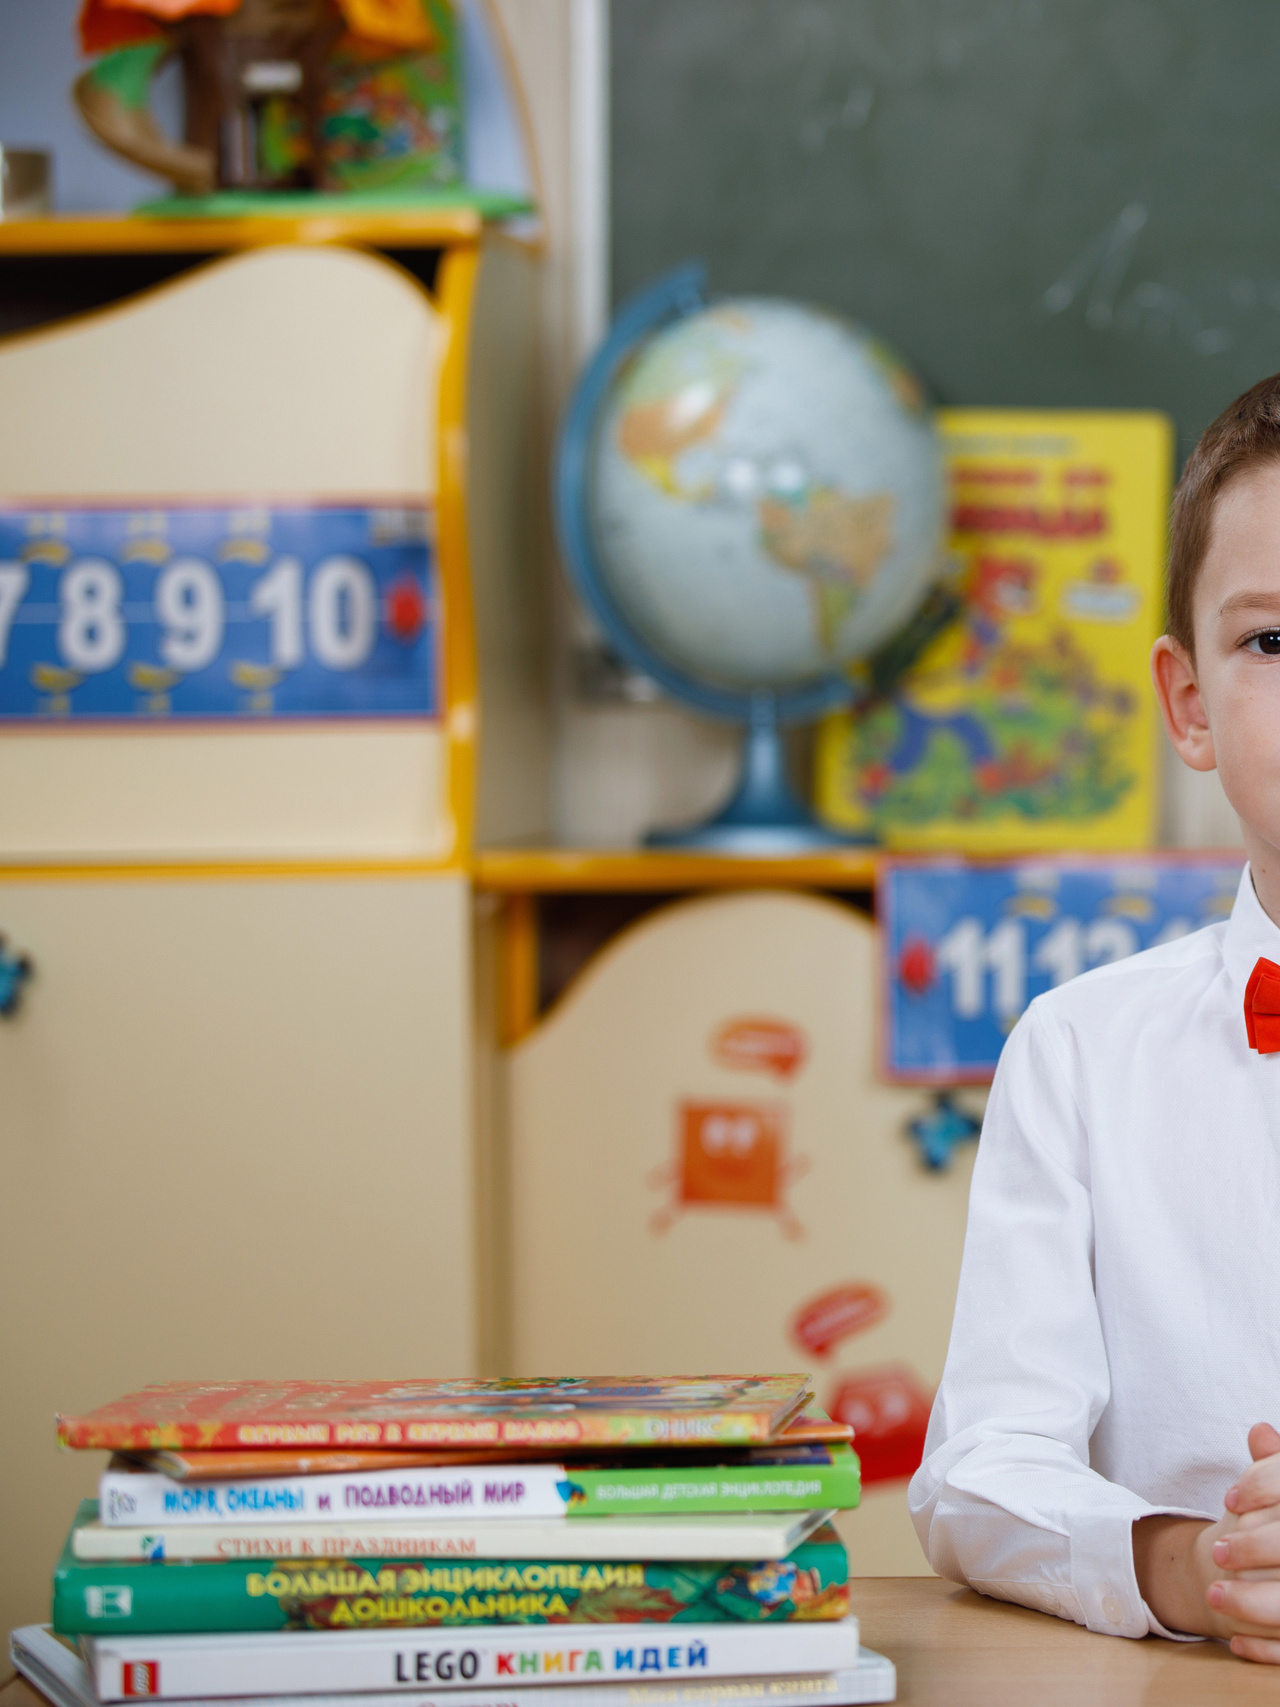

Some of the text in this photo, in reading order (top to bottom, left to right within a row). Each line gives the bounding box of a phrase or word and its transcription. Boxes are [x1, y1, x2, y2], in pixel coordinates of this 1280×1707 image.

[58, 558, 126, 672] 8
[154, 558, 225, 672] 9
[250, 556, 376, 672] 10
[938, 917, 1026, 1022] 11
[644, 1415, 722, 1438] ОНИКС
[163, 1489, 223, 1516] МОРЯ,
[227, 1487, 304, 1512] ОКЕАНЫ
[318, 1495, 331, 1512] и
[345, 1480, 473, 1508] ПОДВОДНЫЙ
[484, 1482, 526, 1506] МИР
[596, 1479, 822, 1501] БОЛЬШАЯ ДЕТСКАЯ ЭНЦИКЛОПЕДИЯ
[216, 1536, 477, 1557] СТИХИ К ПРАЗДНИКАМ
[246, 1563, 645, 1598] БОЛЬШАЯ ЭНЦИКЛОПЕДИЯ
[330, 1594, 570, 1624] ДОШКОЛЬНИКА
[395, 1640, 708, 1683] LEGO КНИГА ИДЕЙ
